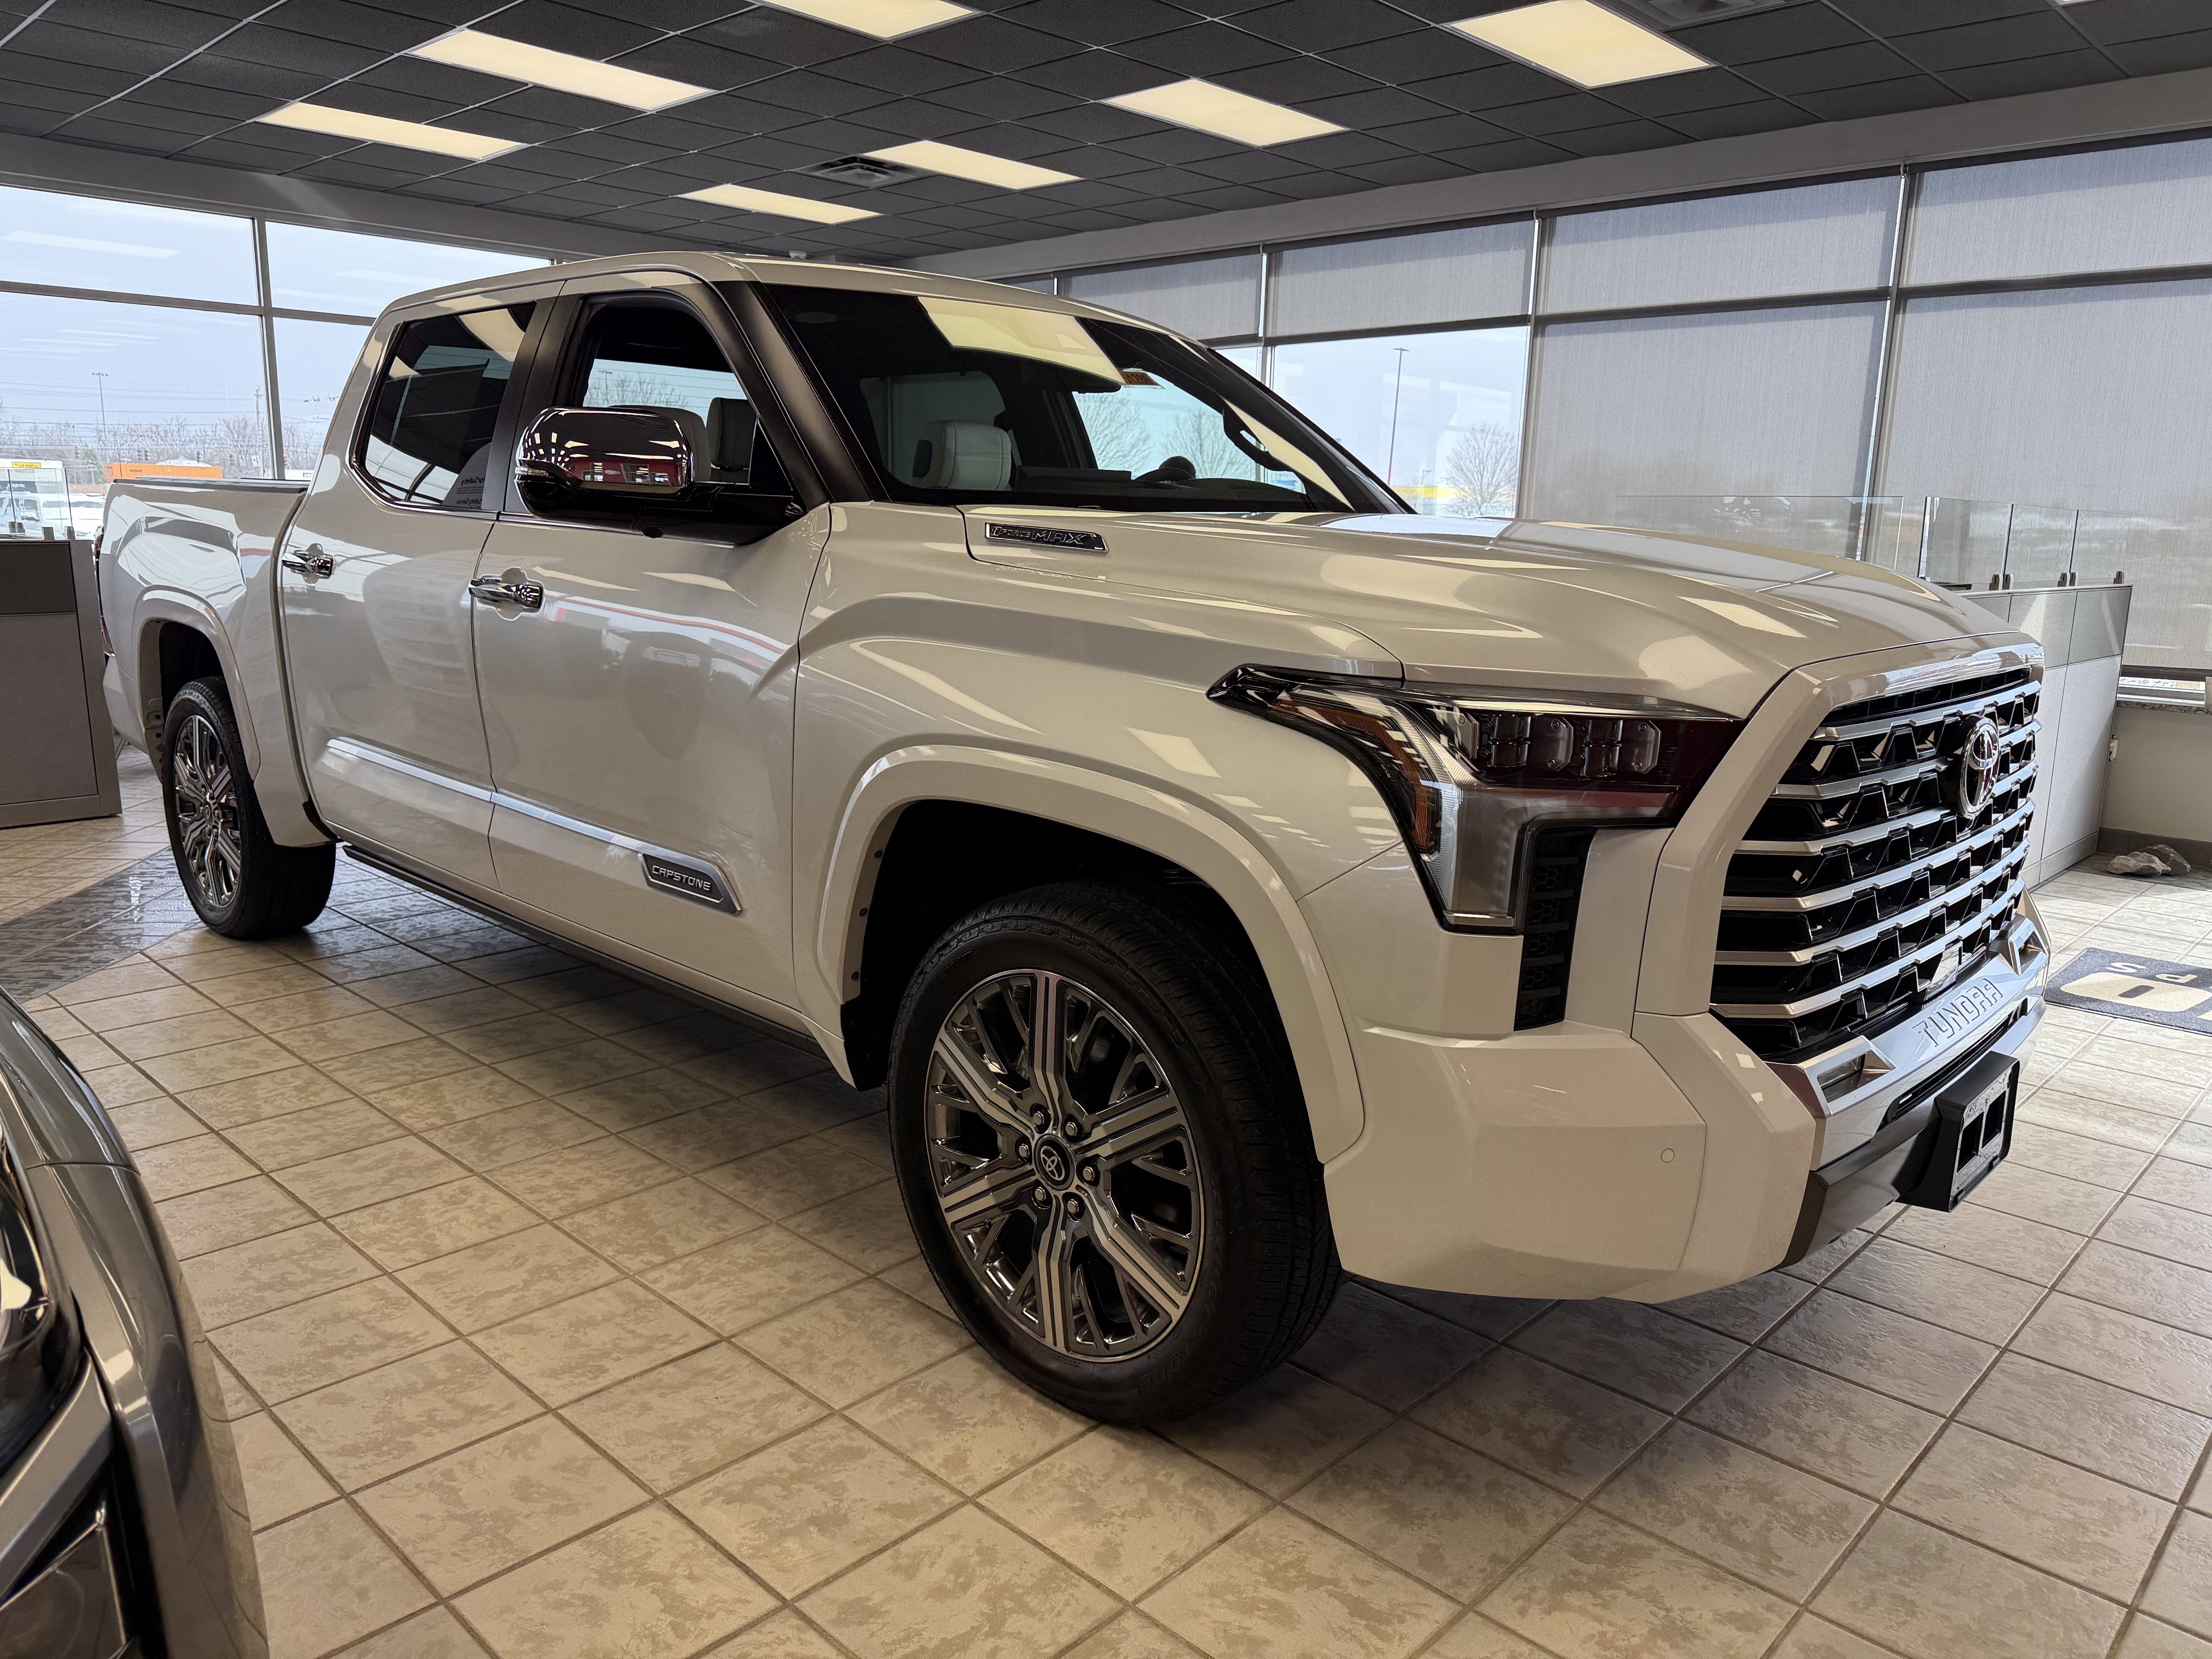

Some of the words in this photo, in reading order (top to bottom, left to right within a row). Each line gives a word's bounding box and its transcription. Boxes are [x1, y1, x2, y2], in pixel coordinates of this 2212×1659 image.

[1031, 529, 1086, 544] MAX
[652, 865, 711, 891] CAPSTONE
[1911, 978, 2004, 1047] TUNDRA
